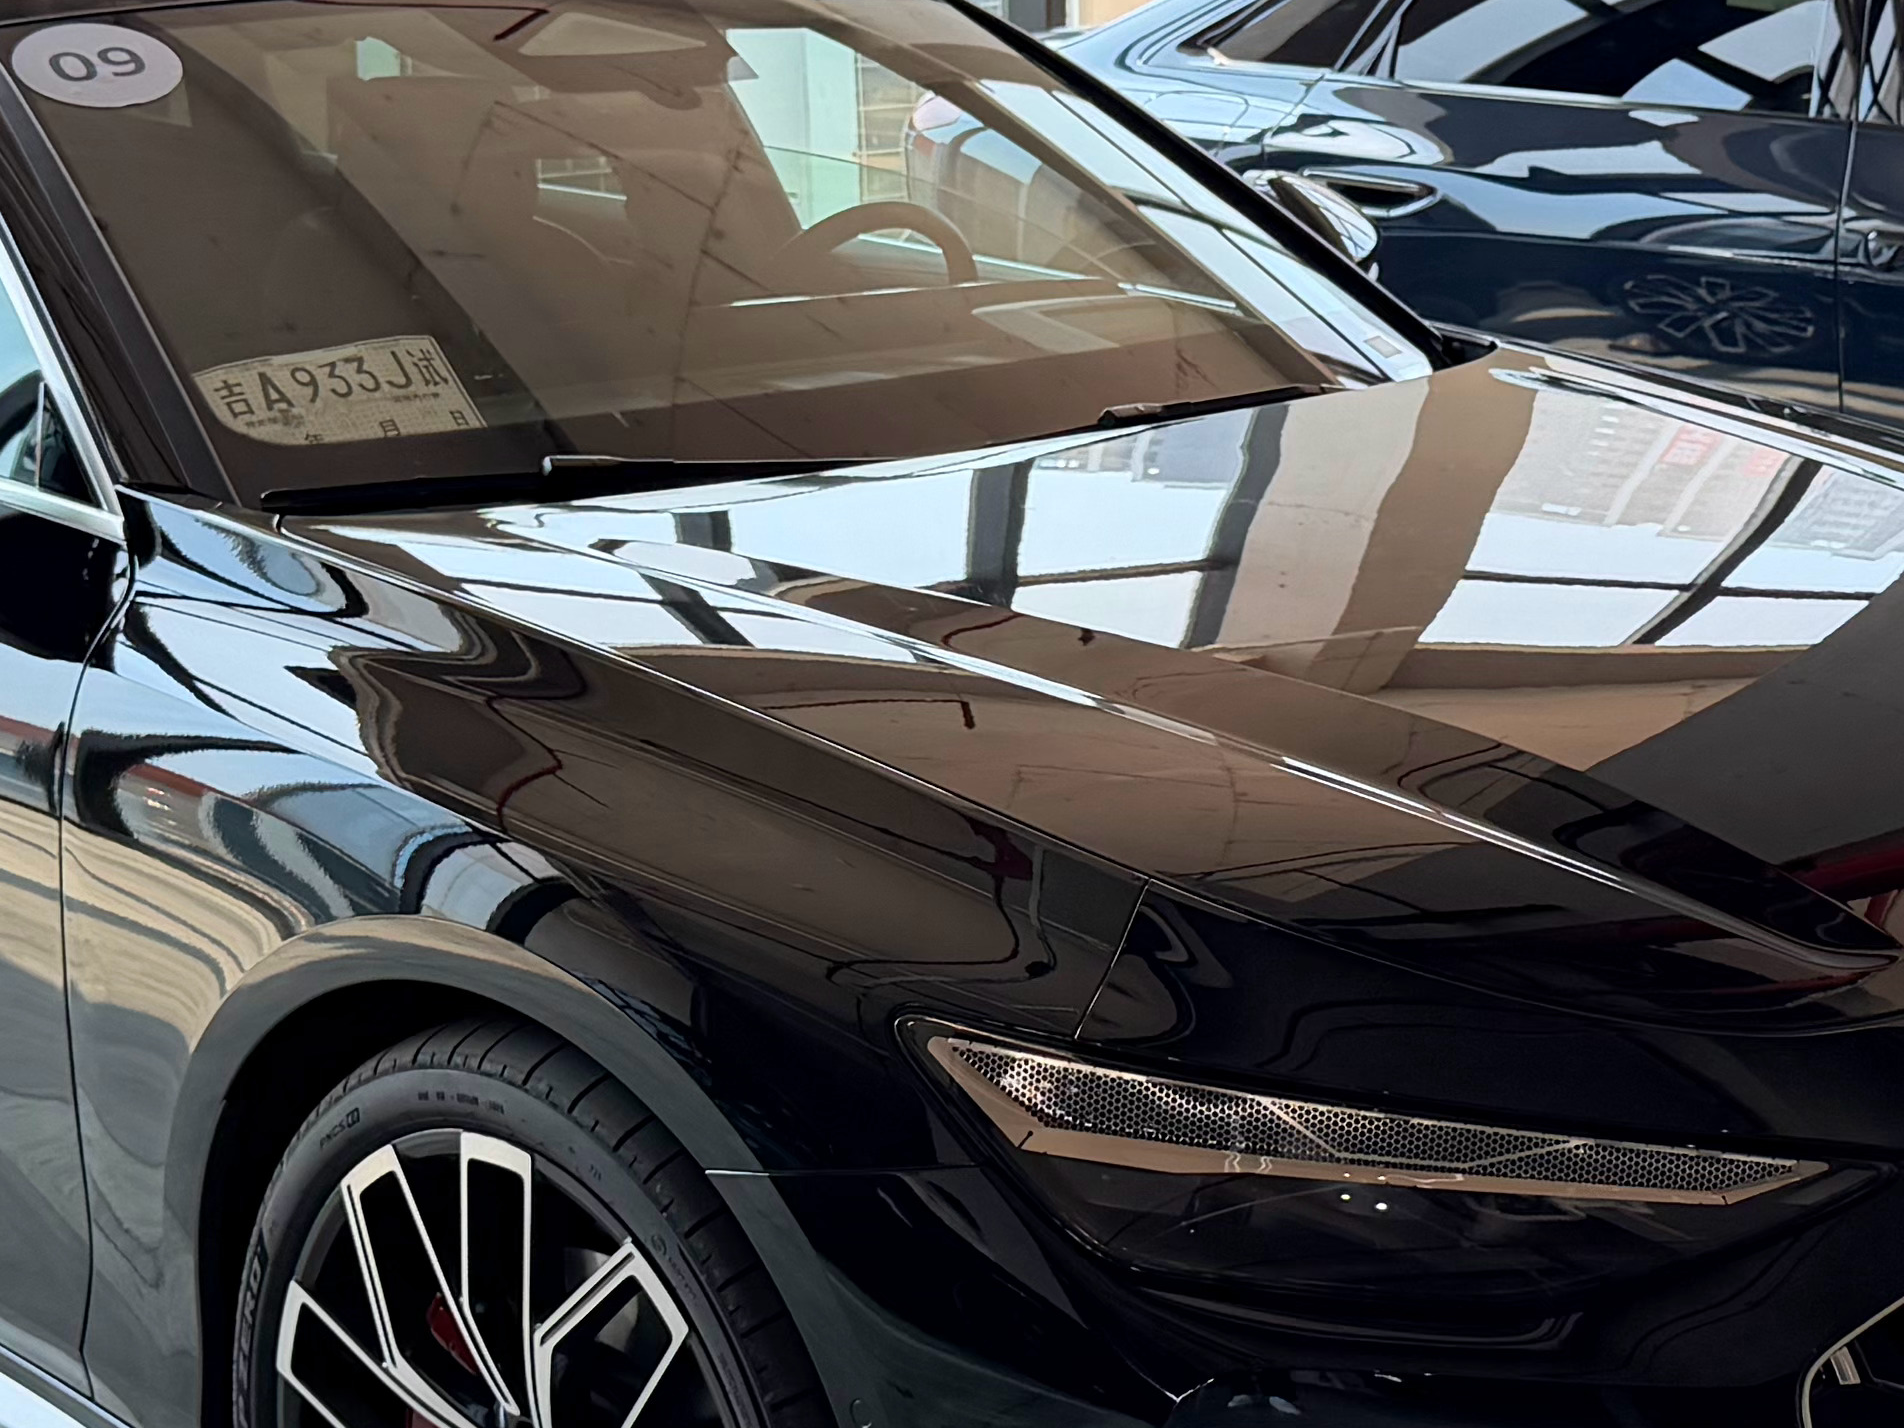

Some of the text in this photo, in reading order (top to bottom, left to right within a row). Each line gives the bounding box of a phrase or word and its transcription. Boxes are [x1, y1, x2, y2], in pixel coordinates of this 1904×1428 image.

[48, 46, 146, 82] 09
[214, 348, 449, 420] 吉A933J试
[379, 417, 401, 438] 月
[449, 409, 471, 428] 日
